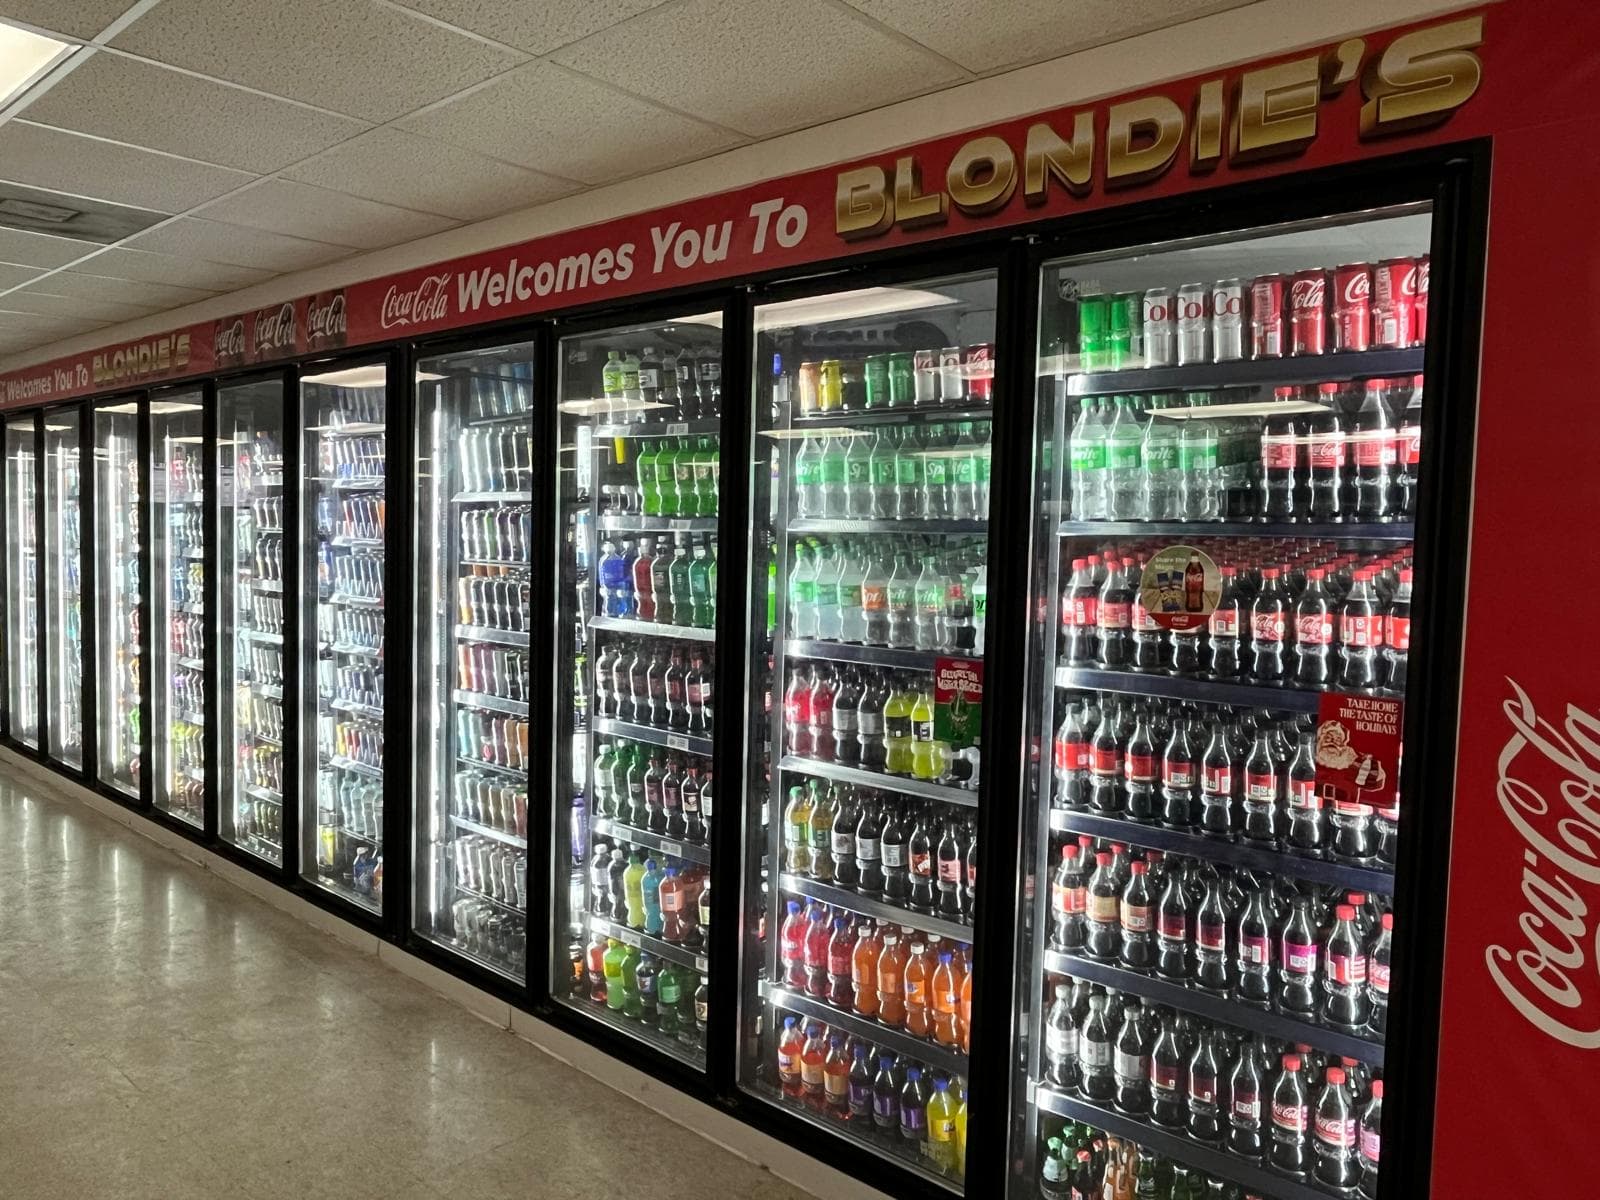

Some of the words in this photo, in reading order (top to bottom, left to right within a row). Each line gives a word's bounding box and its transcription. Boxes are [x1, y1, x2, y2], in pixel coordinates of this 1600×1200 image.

[458, 243, 635, 313] Welcomes
[650, 222, 733, 274] You
[750, 197, 808, 255] To
[7, 374, 52, 401] Welcomes
[54, 367, 73, 392] You
[75, 363, 89, 387] To
[93, 333, 191, 383] BLONDIE'S
[1347, 698, 1370, 710] TAKE
[1371, 702, 1399, 713] HOME
[1339, 708, 1356, 719] THE
[1357, 710, 1384, 722] TASTE
[1384, 713, 1399, 724] OF
[1356, 720, 1397, 735] HOLIDAYS
